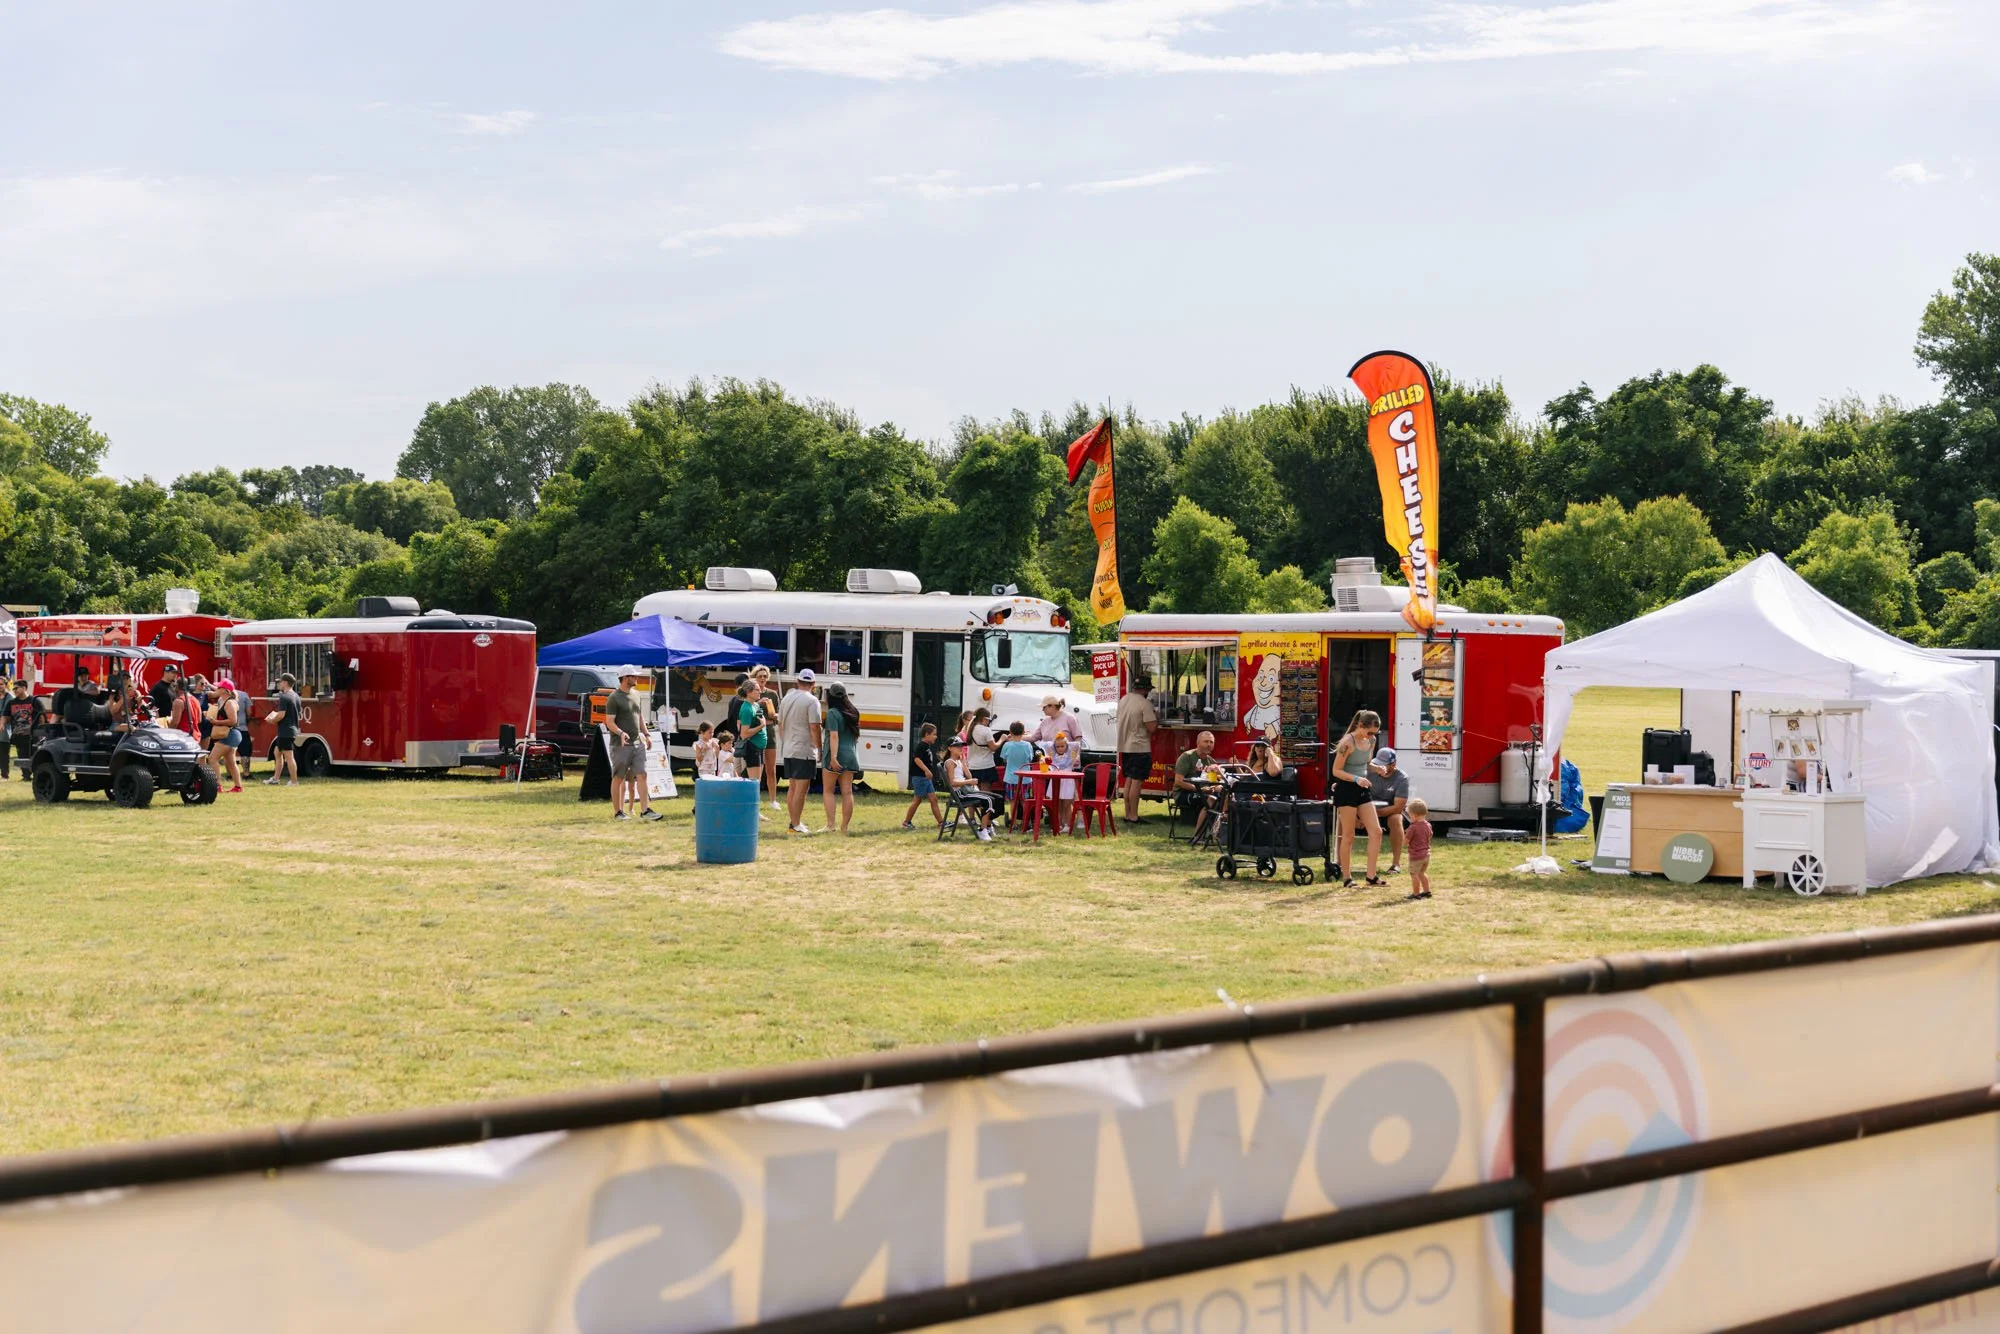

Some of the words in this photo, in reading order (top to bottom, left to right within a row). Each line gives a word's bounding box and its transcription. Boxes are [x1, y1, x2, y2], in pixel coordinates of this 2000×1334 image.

[1370, 384, 1425, 416] GRILLED
[1388, 410, 1428, 597] CHEESE
[1269, 640, 1290, 648] cheese
[1292, 640, 1298, 648] &
[1300, 640, 1320, 648] more!
[1094, 654, 1114, 663] ORDER
[1093, 663, 1107, 671] PICK
[1107, 661, 1116, 669] UP
[1672, 846, 1704, 857] NIBBLE
